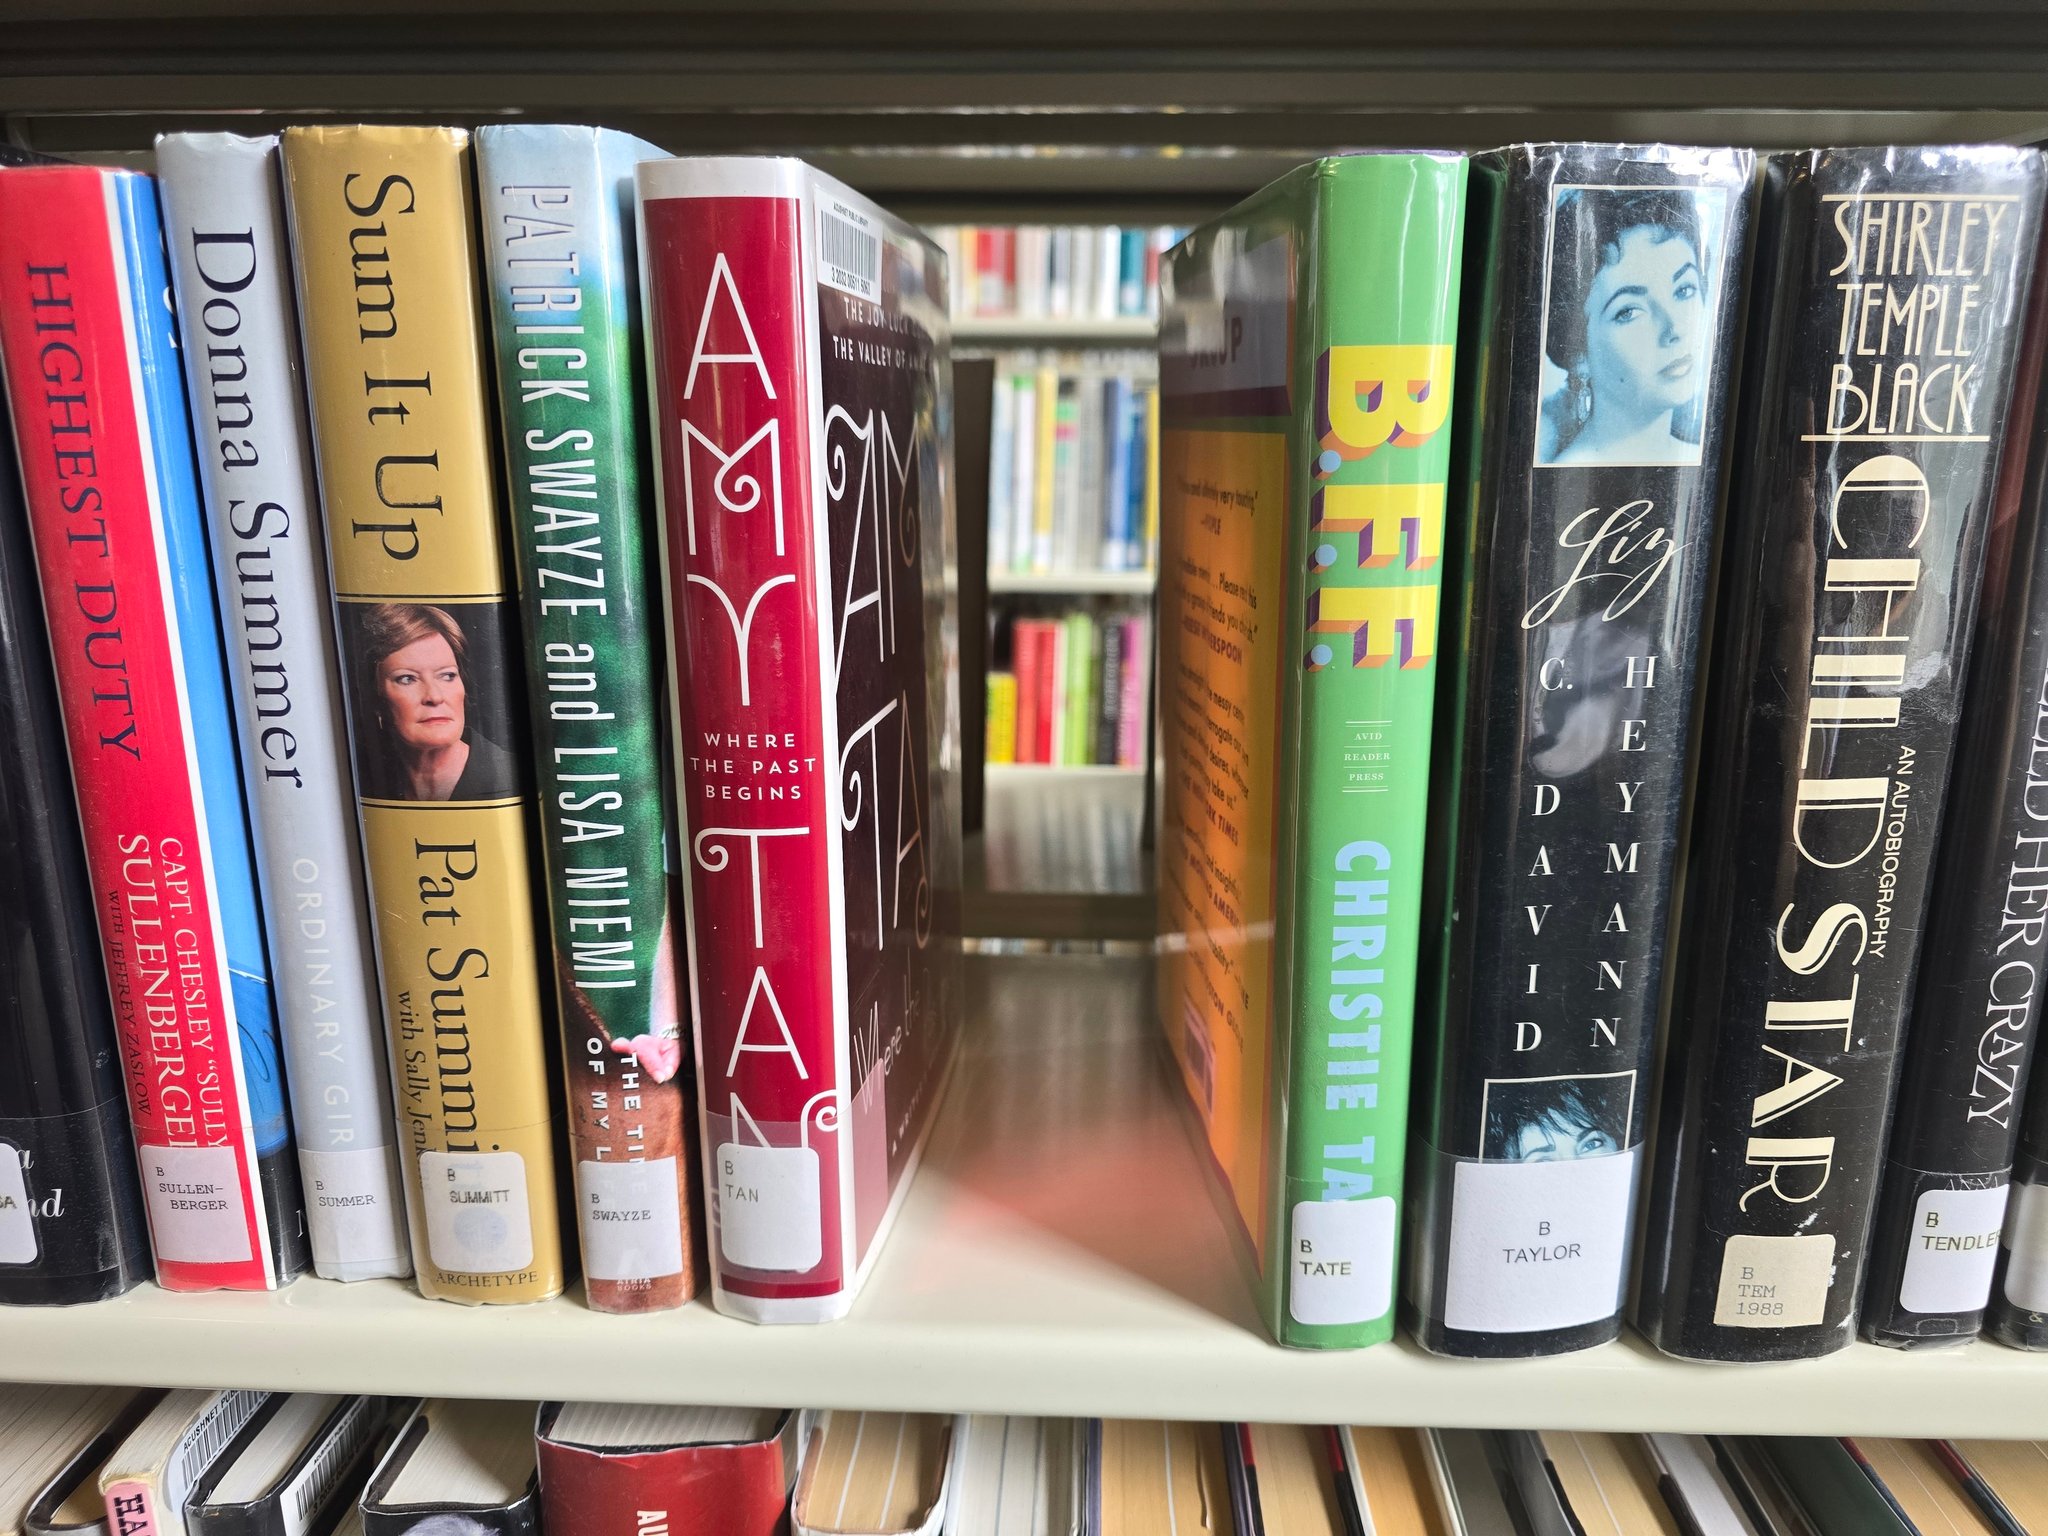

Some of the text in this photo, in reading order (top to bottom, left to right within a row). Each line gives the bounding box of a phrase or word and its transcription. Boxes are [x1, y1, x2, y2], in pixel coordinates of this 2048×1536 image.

[1830, 201, 2008, 277] SHIRLEY
[843, 297, 864, 324] THE
[867, 305, 886, 328] JOY
[1836, 283, 1981, 358] TEMPLE
[343, 173, 444, 561] Sum It Up
[832, 335, 854, 362] THE
[857, 340, 893, 367] VALLEY
[895, 347, 906, 370] OF
[1826, 362, 1977, 436] BLACK
[680, 252, 798, 707] AMY
[27, 262, 142, 761] HIGHEST DUTY
[191, 226, 303, 789] Donna Summer
[1303, 344, 1455, 673] B.F.F.
[824, 402, 919, 695] AM
[1520, 500, 1694, 630] Liz
[500, 184, 638, 989] PATRICK SWAYZE and LISA NIEMI
[703, 732, 797, 749] WHERE
[1354, 732, 1382, 741] AVID
[690, 757, 817, 774] THE PAST
[1343, 752, 1391, 761] READER
[705, 783, 802, 800] BEGINS
[1349, 773, 1384, 781] PRESS
[840, 690, 931, 950] TA
[1218, 814, 1240, 847] TIMES
[1737, 454, 1930, 1213] CHILD STAR
[1513, 656, 1574, 1053] C. DAVID
[1589, 656, 1656, 1048] HEYMANN
[1869, 745, 1917, 959] AN AUTOBIOGRAPHY
[160, 836, 194, 920] CAPT.
[107, 889, 152, 1116] WITH JEFFREY ZASLOW
[173, 927, 215, 1053] CHESLEY
[292, 856, 354, 1146] ORDINARY GIR
[414, 837, 500, 1153] Pat Summi
[397, 990, 416, 1043] with
[1321, 839, 1392, 1202] CHRISTIE TA
[586, 1037, 605, 1076] OF
[1966, 961, 2036, 1130] CRAZY
[402, 1047, 429, 1107] Sally
[620, 1052, 643, 1111] THE
[591, 1091, 611, 1131] MY
[156, 1167, 165, 1177] B
[315, 1180, 324, 1191] B
[447, 1168, 456, 1182] B
[725, 1160, 734, 1176] B
[159, 1183, 224, 1195] SULLEN-
[170, 1200, 229, 1211] BERGER
[318, 1195, 376, 1207] SUMMER
[449, 1189, 510, 1204] SUMMITT
[591, 1193, 600, 1204] B
[726, 1183, 760, 1203] TAN
[592, 1209, 652, 1221] SWAYZE
[1538, 1221, 1551, 1236] B
[1926, 1211, 1939, 1228] B
[1300, 1239, 1312, 1253] B
[1502, 1243, 1581, 1264] TAYLOR
[436, 1271, 539, 1287] ARCHETYPE
[1299, 1260, 1352, 1276] TATE
[1740, 1266, 1755, 1280] B
[1735, 1302, 1784, 1316] 1988
[1738, 1284, 1776, 1298] TEM
[183, 1390, 241, 1451] ACUSHNET PUB
